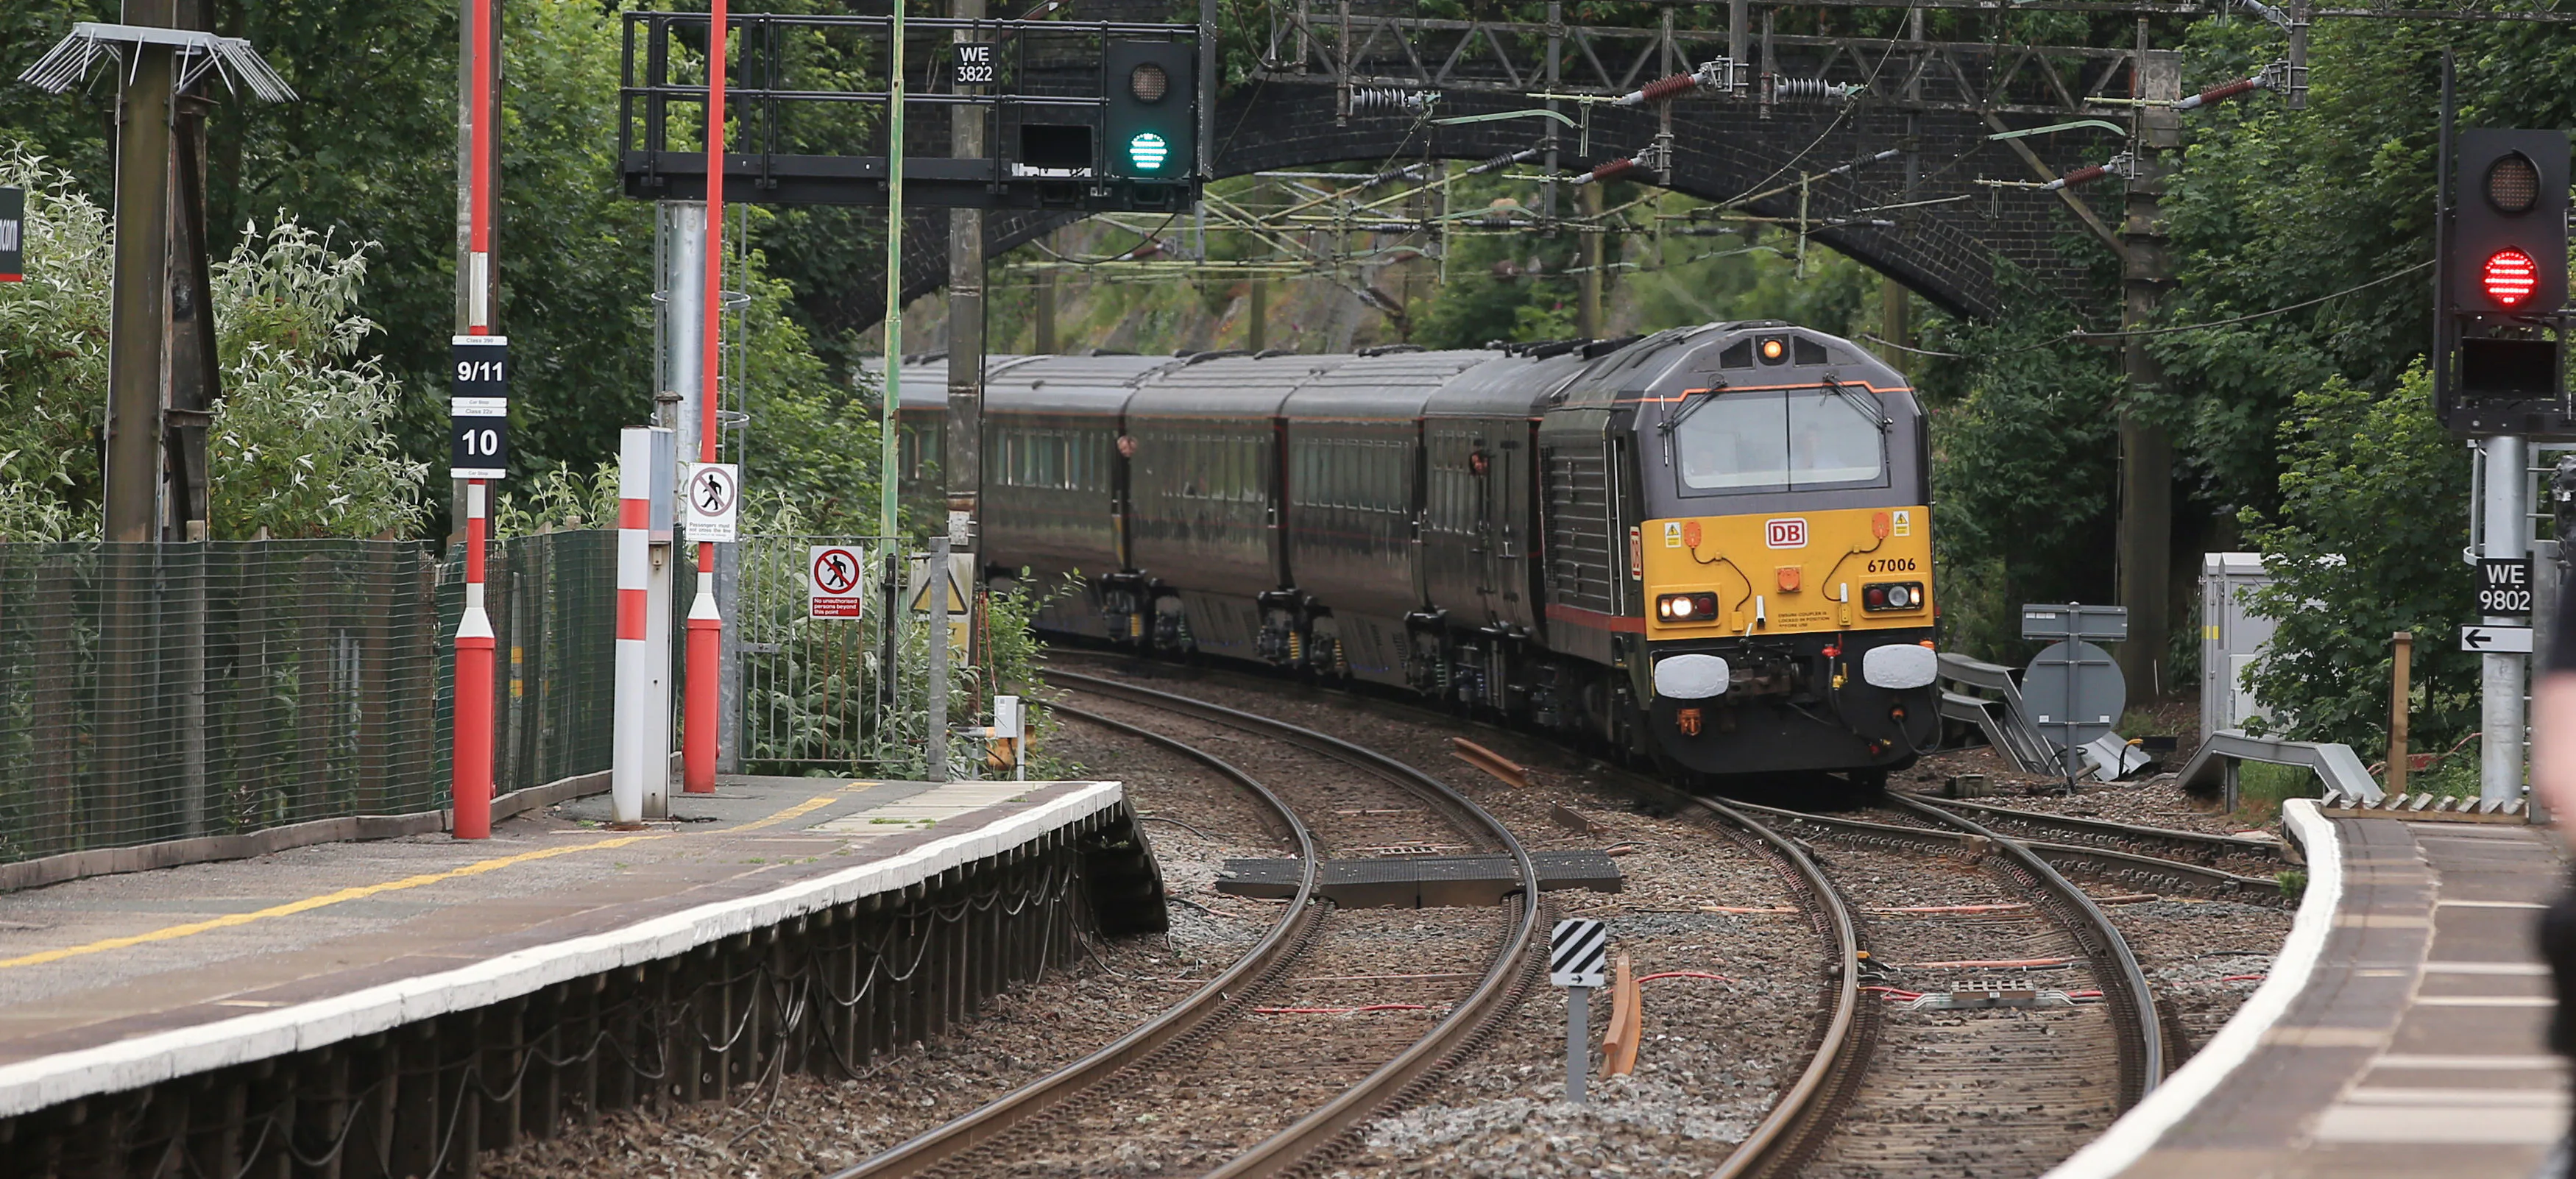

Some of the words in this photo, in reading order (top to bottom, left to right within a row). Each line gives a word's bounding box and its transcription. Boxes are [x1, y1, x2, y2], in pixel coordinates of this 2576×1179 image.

[960, 47, 989, 61] WE
[958, 66, 992, 82] 3822
[457, 361, 503, 381] 9/11
[462, 429, 498, 456] 10
[1773, 525, 1800, 542] DB
[1868, 557, 1916, 573] 67006
[2486, 564, 2524, 584] WE
[2480, 590, 2530, 610] 9802
